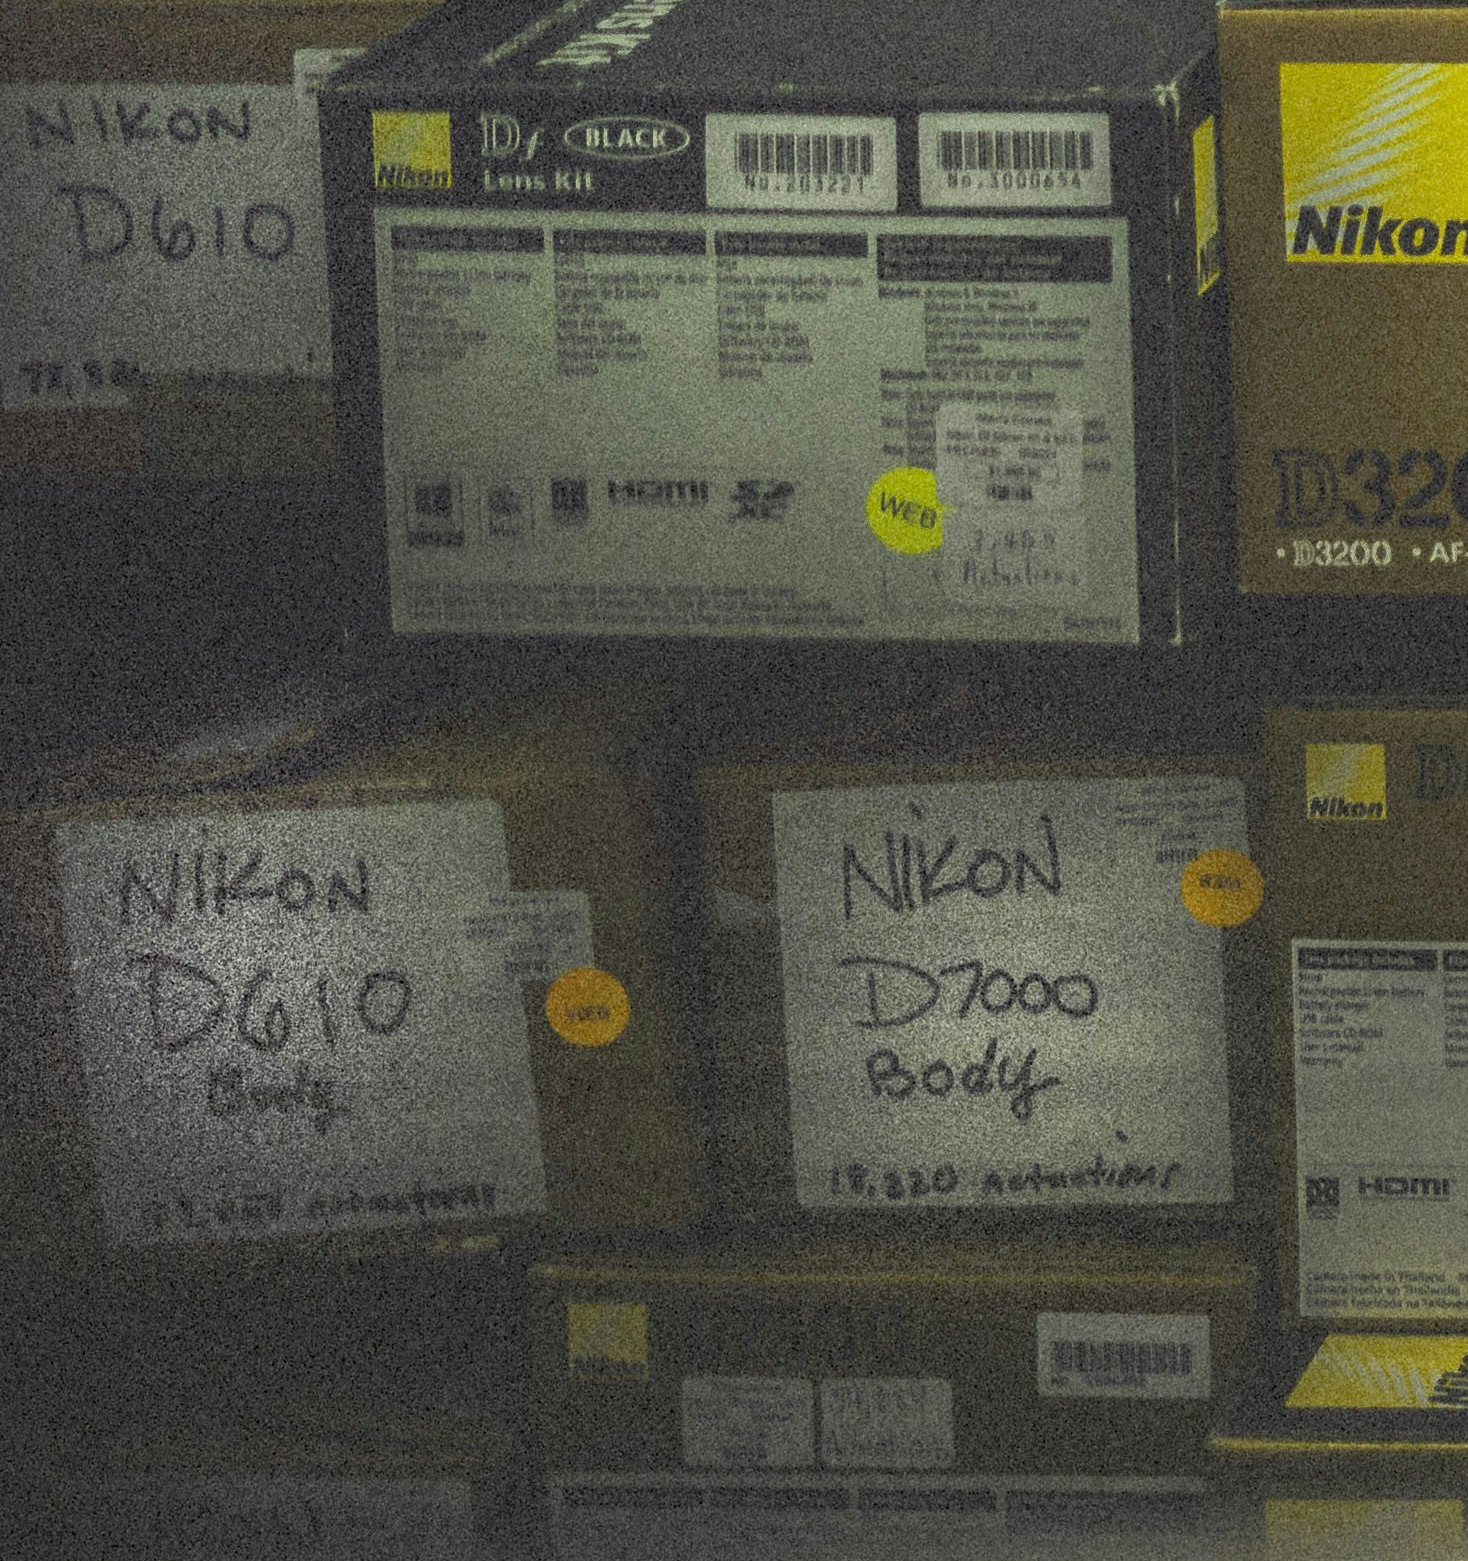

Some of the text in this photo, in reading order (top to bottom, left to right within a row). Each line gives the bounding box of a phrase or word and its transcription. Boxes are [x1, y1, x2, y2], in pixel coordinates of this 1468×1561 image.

[26, 97, 250, 148] NIKON
[585, 127, 668, 150] BLACK
[482, 170, 595, 193] Lens Kit
[57, 185, 294, 264] D610
[1292, 540, 1393, 567] D3200
[1311, 799, 1383, 817] Nikon
[120, 848, 369, 926] NIKON
[129, 953, 411, 1052] D610
[839, 956, 1098, 1029] D7000
[866, 1038, 1061, 1122] Body
